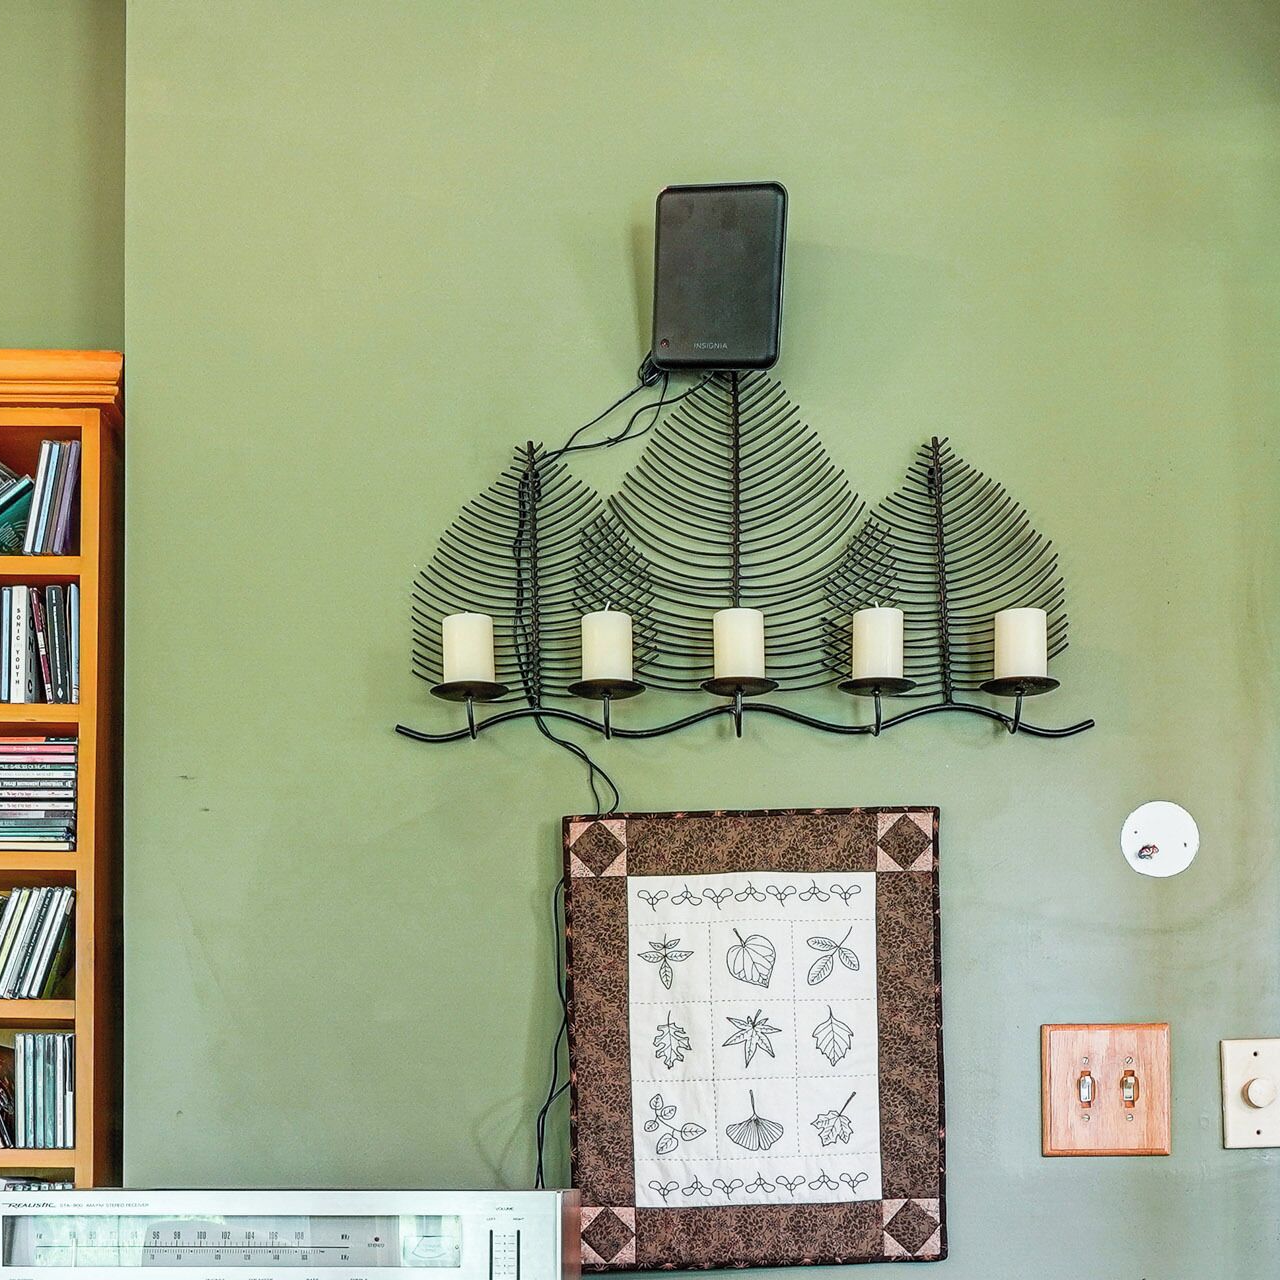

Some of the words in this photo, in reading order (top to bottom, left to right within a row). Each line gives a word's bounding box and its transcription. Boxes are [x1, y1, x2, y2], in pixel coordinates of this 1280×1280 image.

[197, 1231, 207, 1240] 100
[221, 1231, 231, 1240] 102
[245, 1231, 255, 1240] 104
